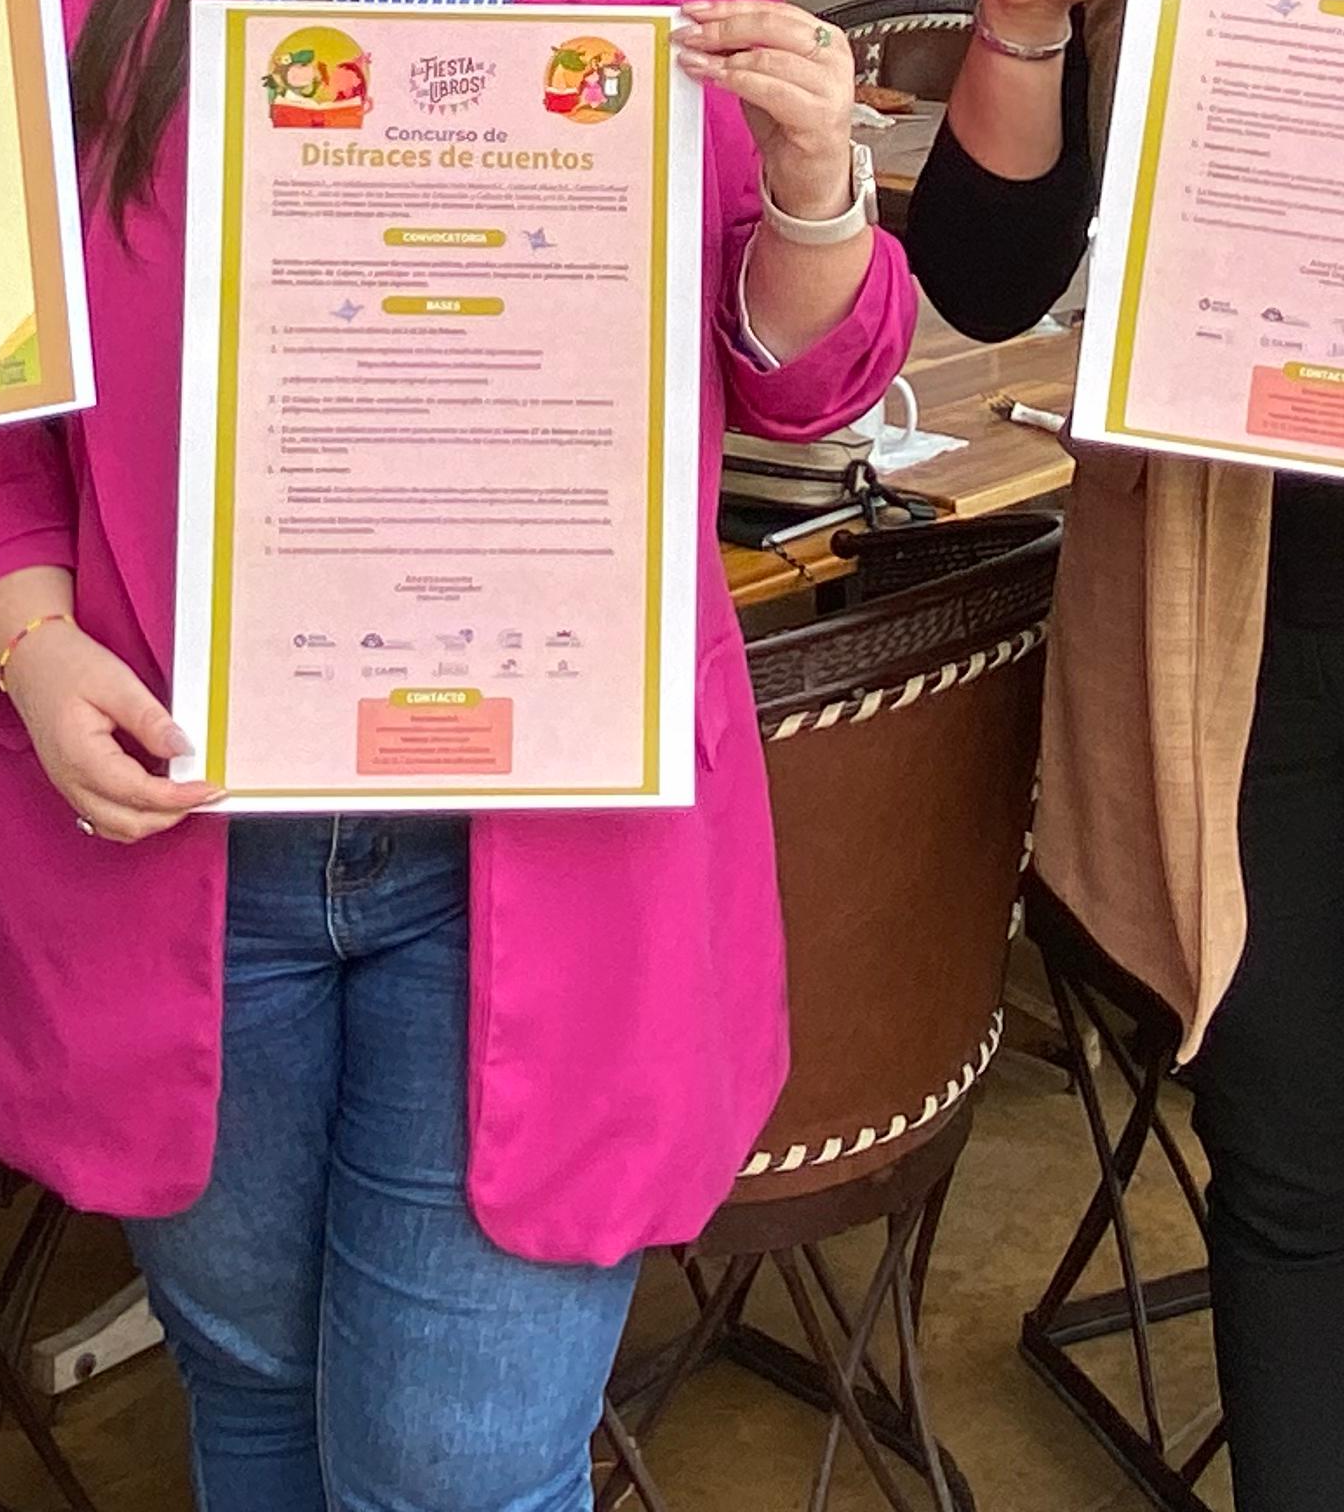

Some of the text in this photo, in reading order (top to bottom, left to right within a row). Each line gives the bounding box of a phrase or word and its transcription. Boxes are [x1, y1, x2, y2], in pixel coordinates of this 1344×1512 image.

[420, 56, 475, 83] FIESTA
[384, 125, 509, 143] Concurso de
[300, 142, 595, 171] Disfraces de cuentos
[402, 231, 487, 244] CONVOCATORIA
[426, 299, 461, 312] BASES
[406, 691, 467, 705] CONTACTO
